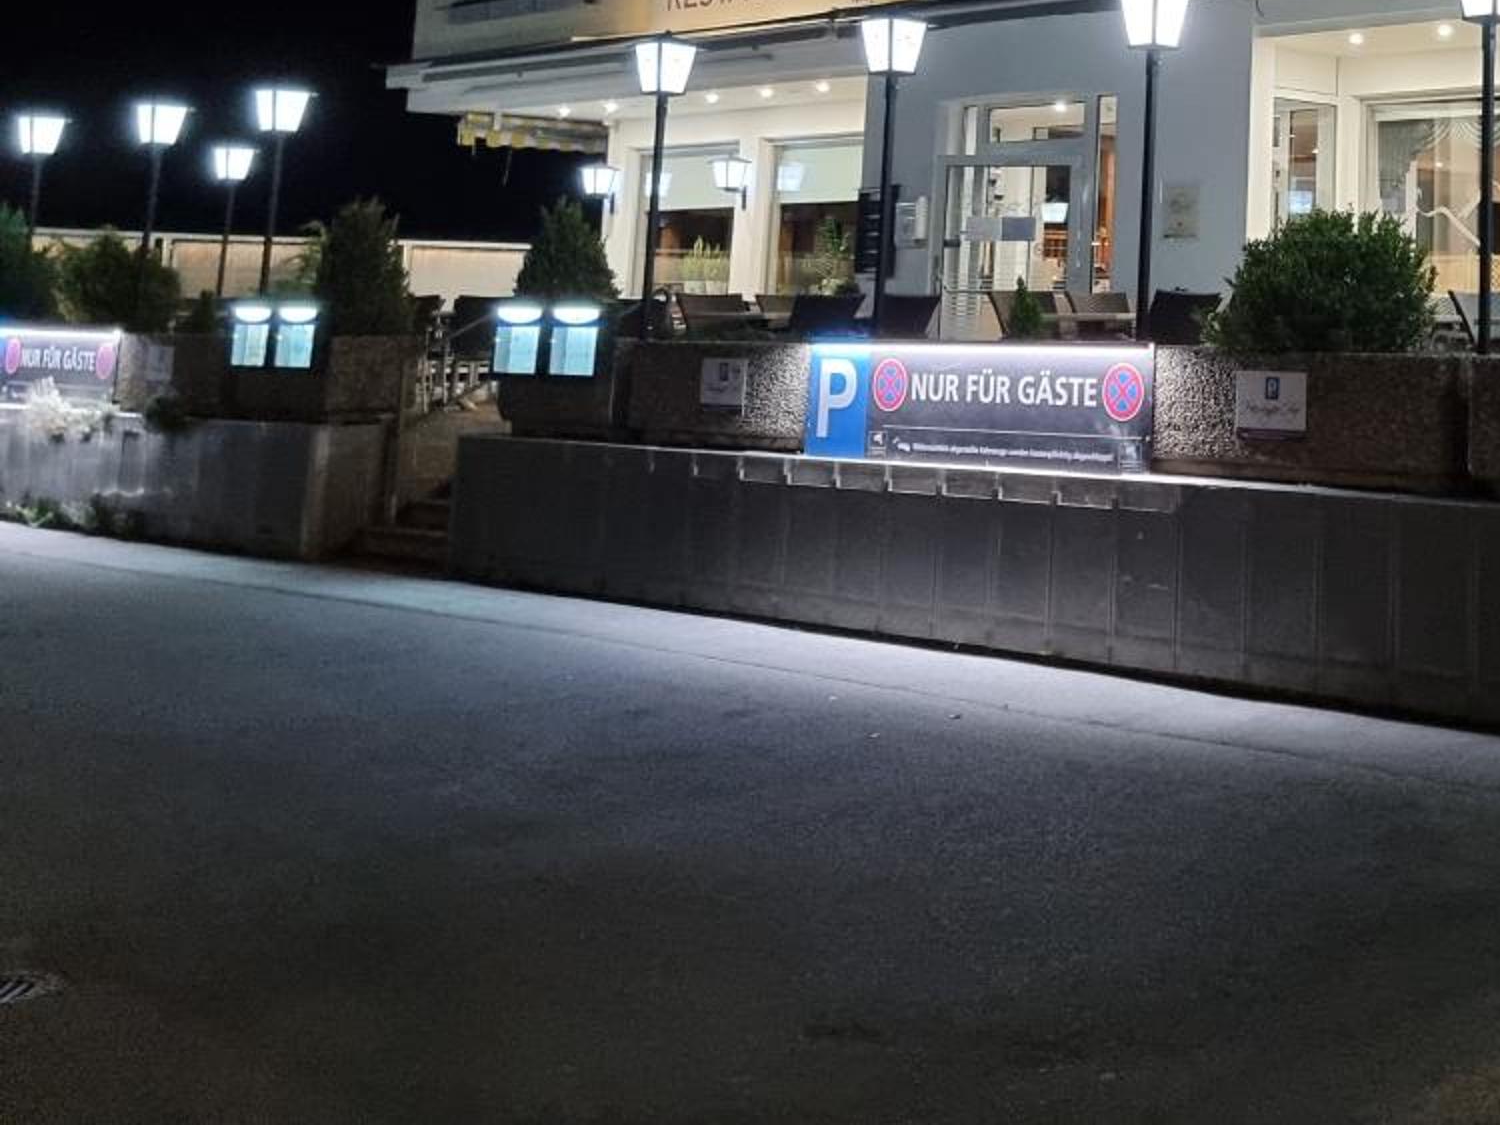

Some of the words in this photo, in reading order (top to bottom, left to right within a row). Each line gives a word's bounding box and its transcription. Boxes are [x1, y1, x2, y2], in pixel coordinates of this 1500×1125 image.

[21, 348, 41, 367] NUR
[42, 345, 61, 369] FÜR
[63, 347, 96, 371] GÄSTE
[816, 358, 857, 438] P
[911, 373, 959, 403] NUR
[966, 369, 1010, 404] FÜR
[1018, 371, 1098, 408] GÄSTE
